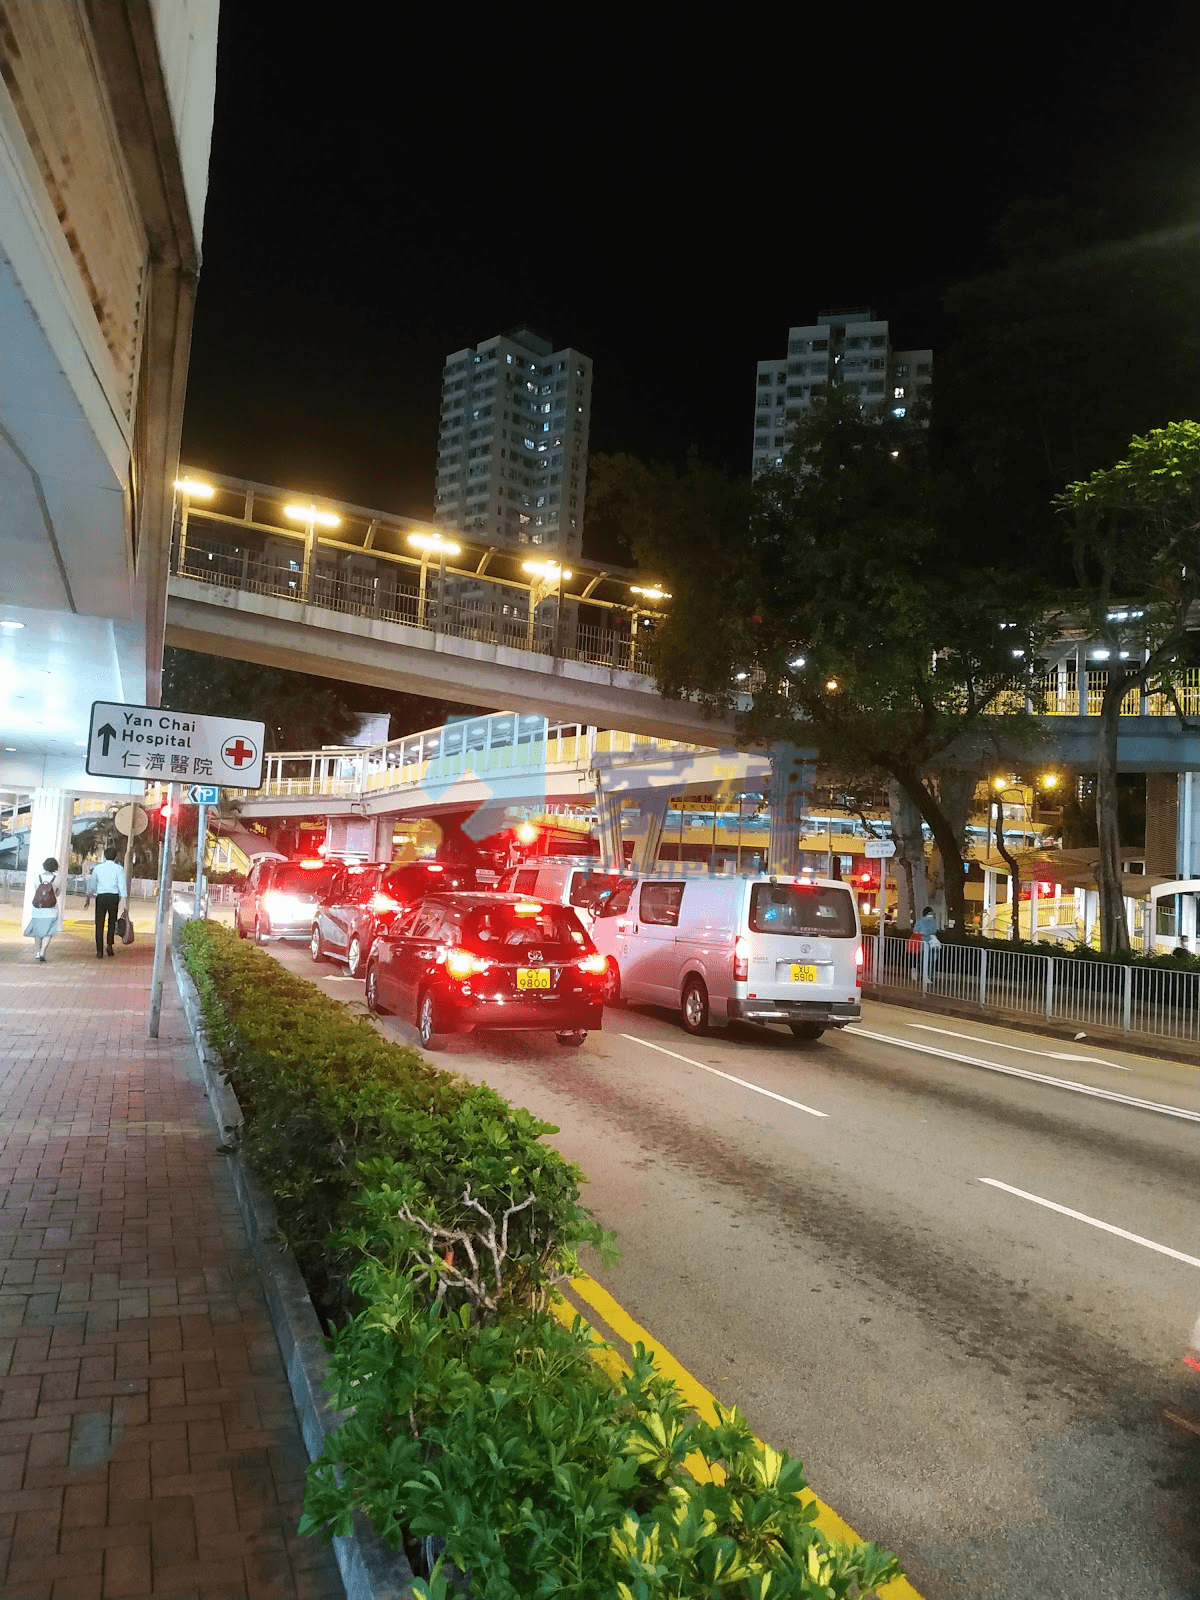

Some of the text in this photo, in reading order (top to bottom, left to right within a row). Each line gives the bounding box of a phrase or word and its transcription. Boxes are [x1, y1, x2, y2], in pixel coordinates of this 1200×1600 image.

[123, 712, 196, 733] Yan Chai
[121, 729, 191, 748] Hospital
[121, 750, 213, 776] 仁濟醫院
[202, 788, 213, 801] P
[527, 969, 540, 979] GY
[799, 965, 810, 974] XU
[794, 973, 814, 982] 5910
[520, 979, 548, 988] 9800
